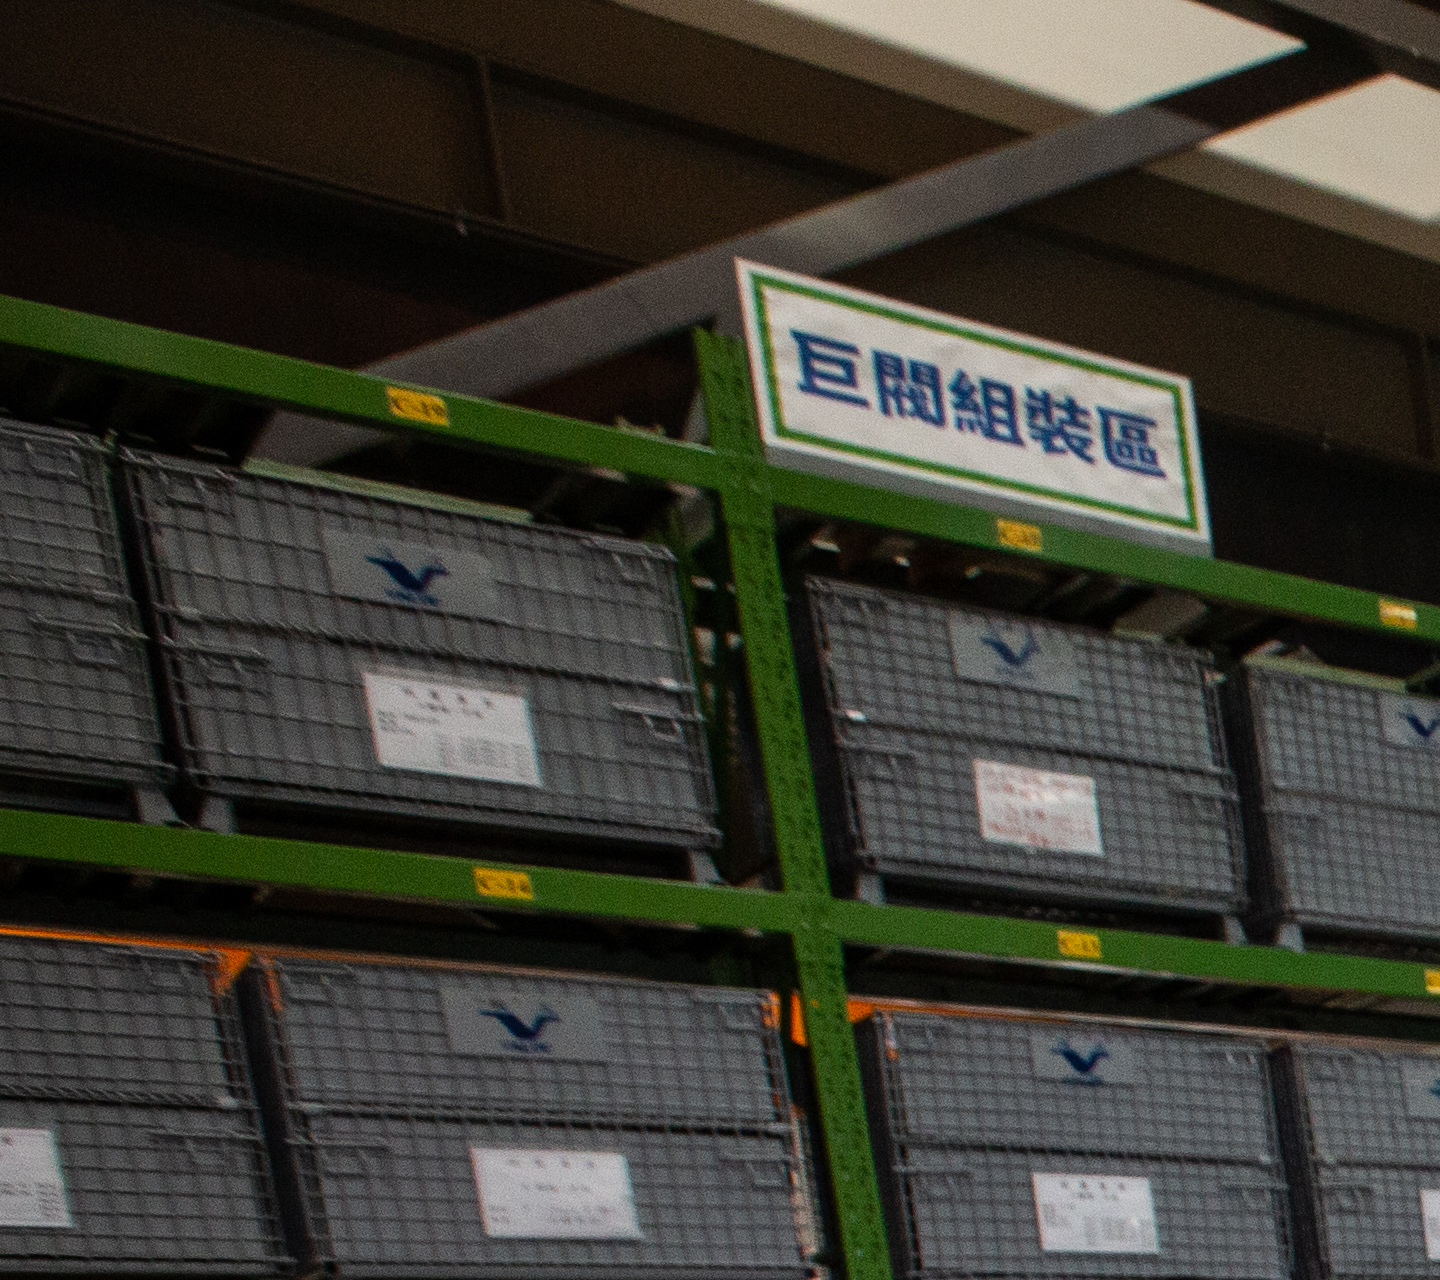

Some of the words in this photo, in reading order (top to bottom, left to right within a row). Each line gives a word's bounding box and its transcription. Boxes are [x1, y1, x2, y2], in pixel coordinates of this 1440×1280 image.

[789, 328, 1168, 479] 巨閥組裝區
